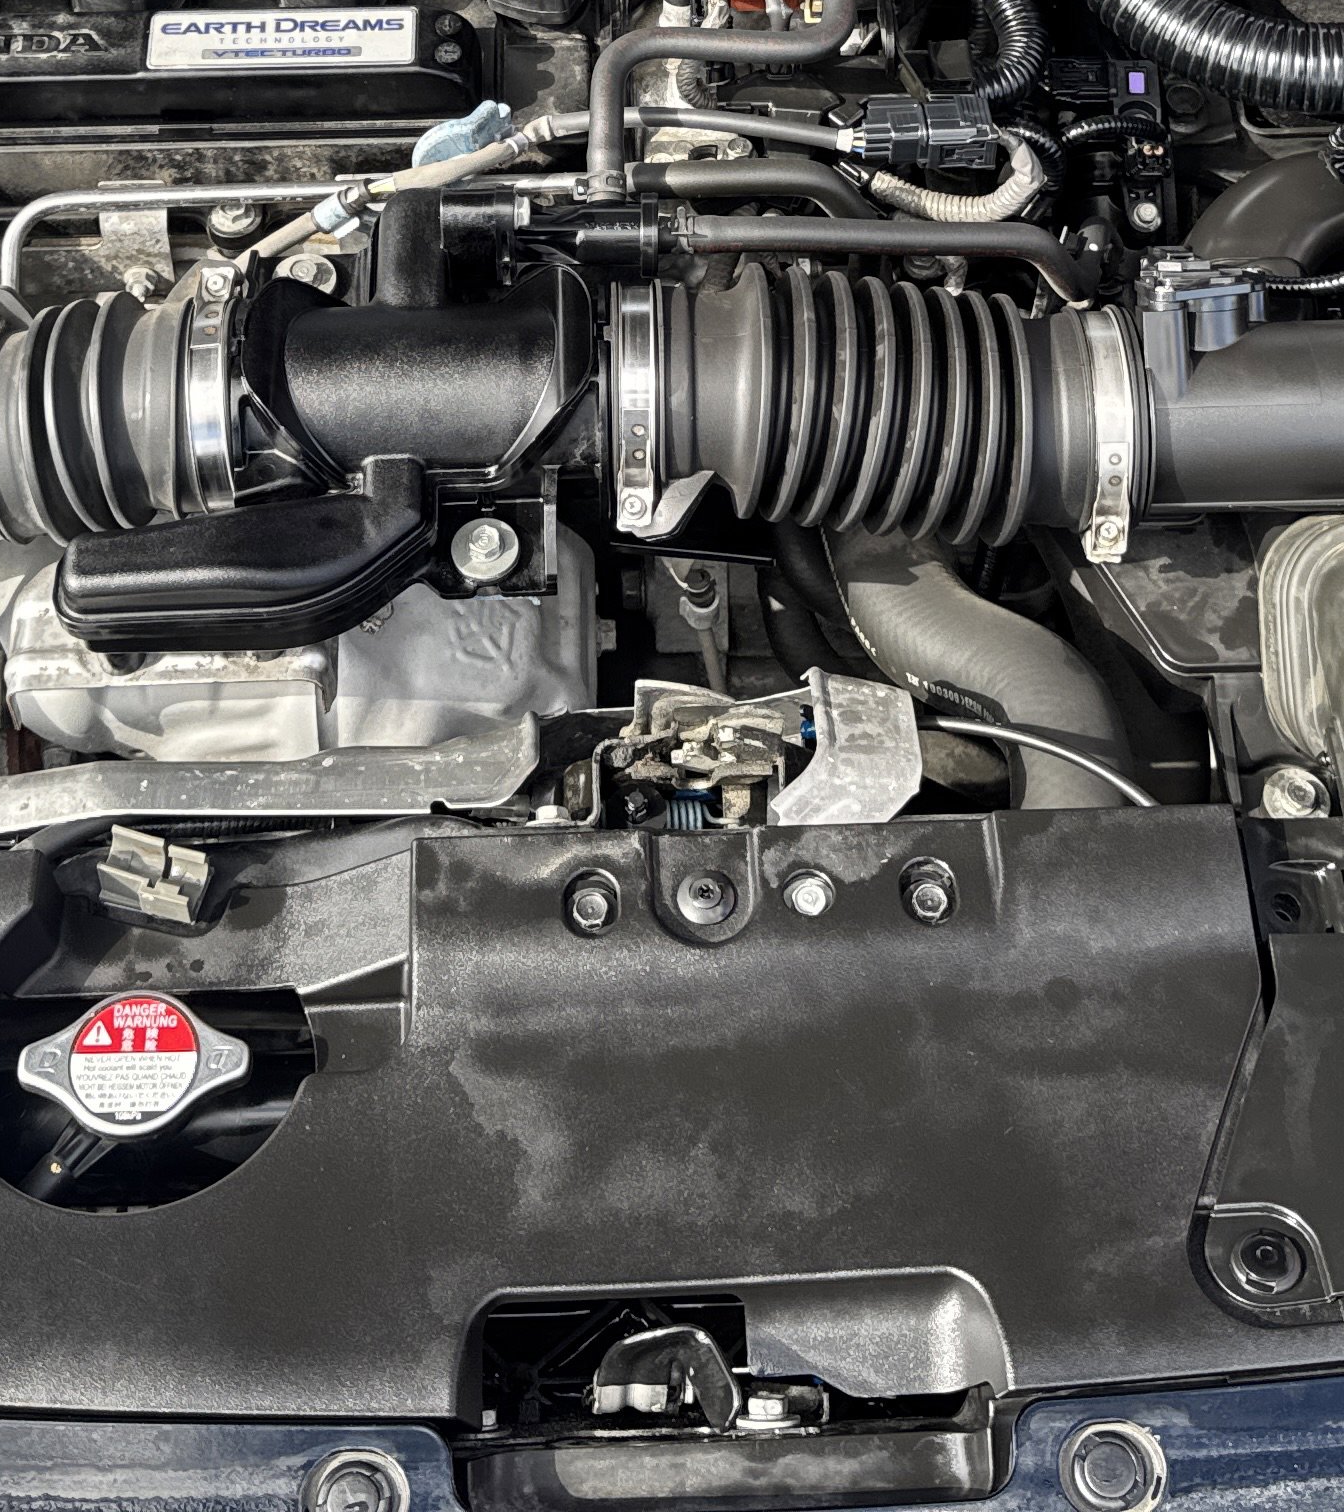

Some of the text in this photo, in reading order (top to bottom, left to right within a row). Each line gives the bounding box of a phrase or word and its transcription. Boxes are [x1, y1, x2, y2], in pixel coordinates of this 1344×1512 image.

[161, 17, 405, 35] EARTH DREAMS
[219, 35, 346, 45] TECHNOLOGY
[213, 47, 352, 58] VTEC TURBO
[113, 1004, 167, 1016] DANGER
[113, 1015, 178, 1028] WARNUNG
